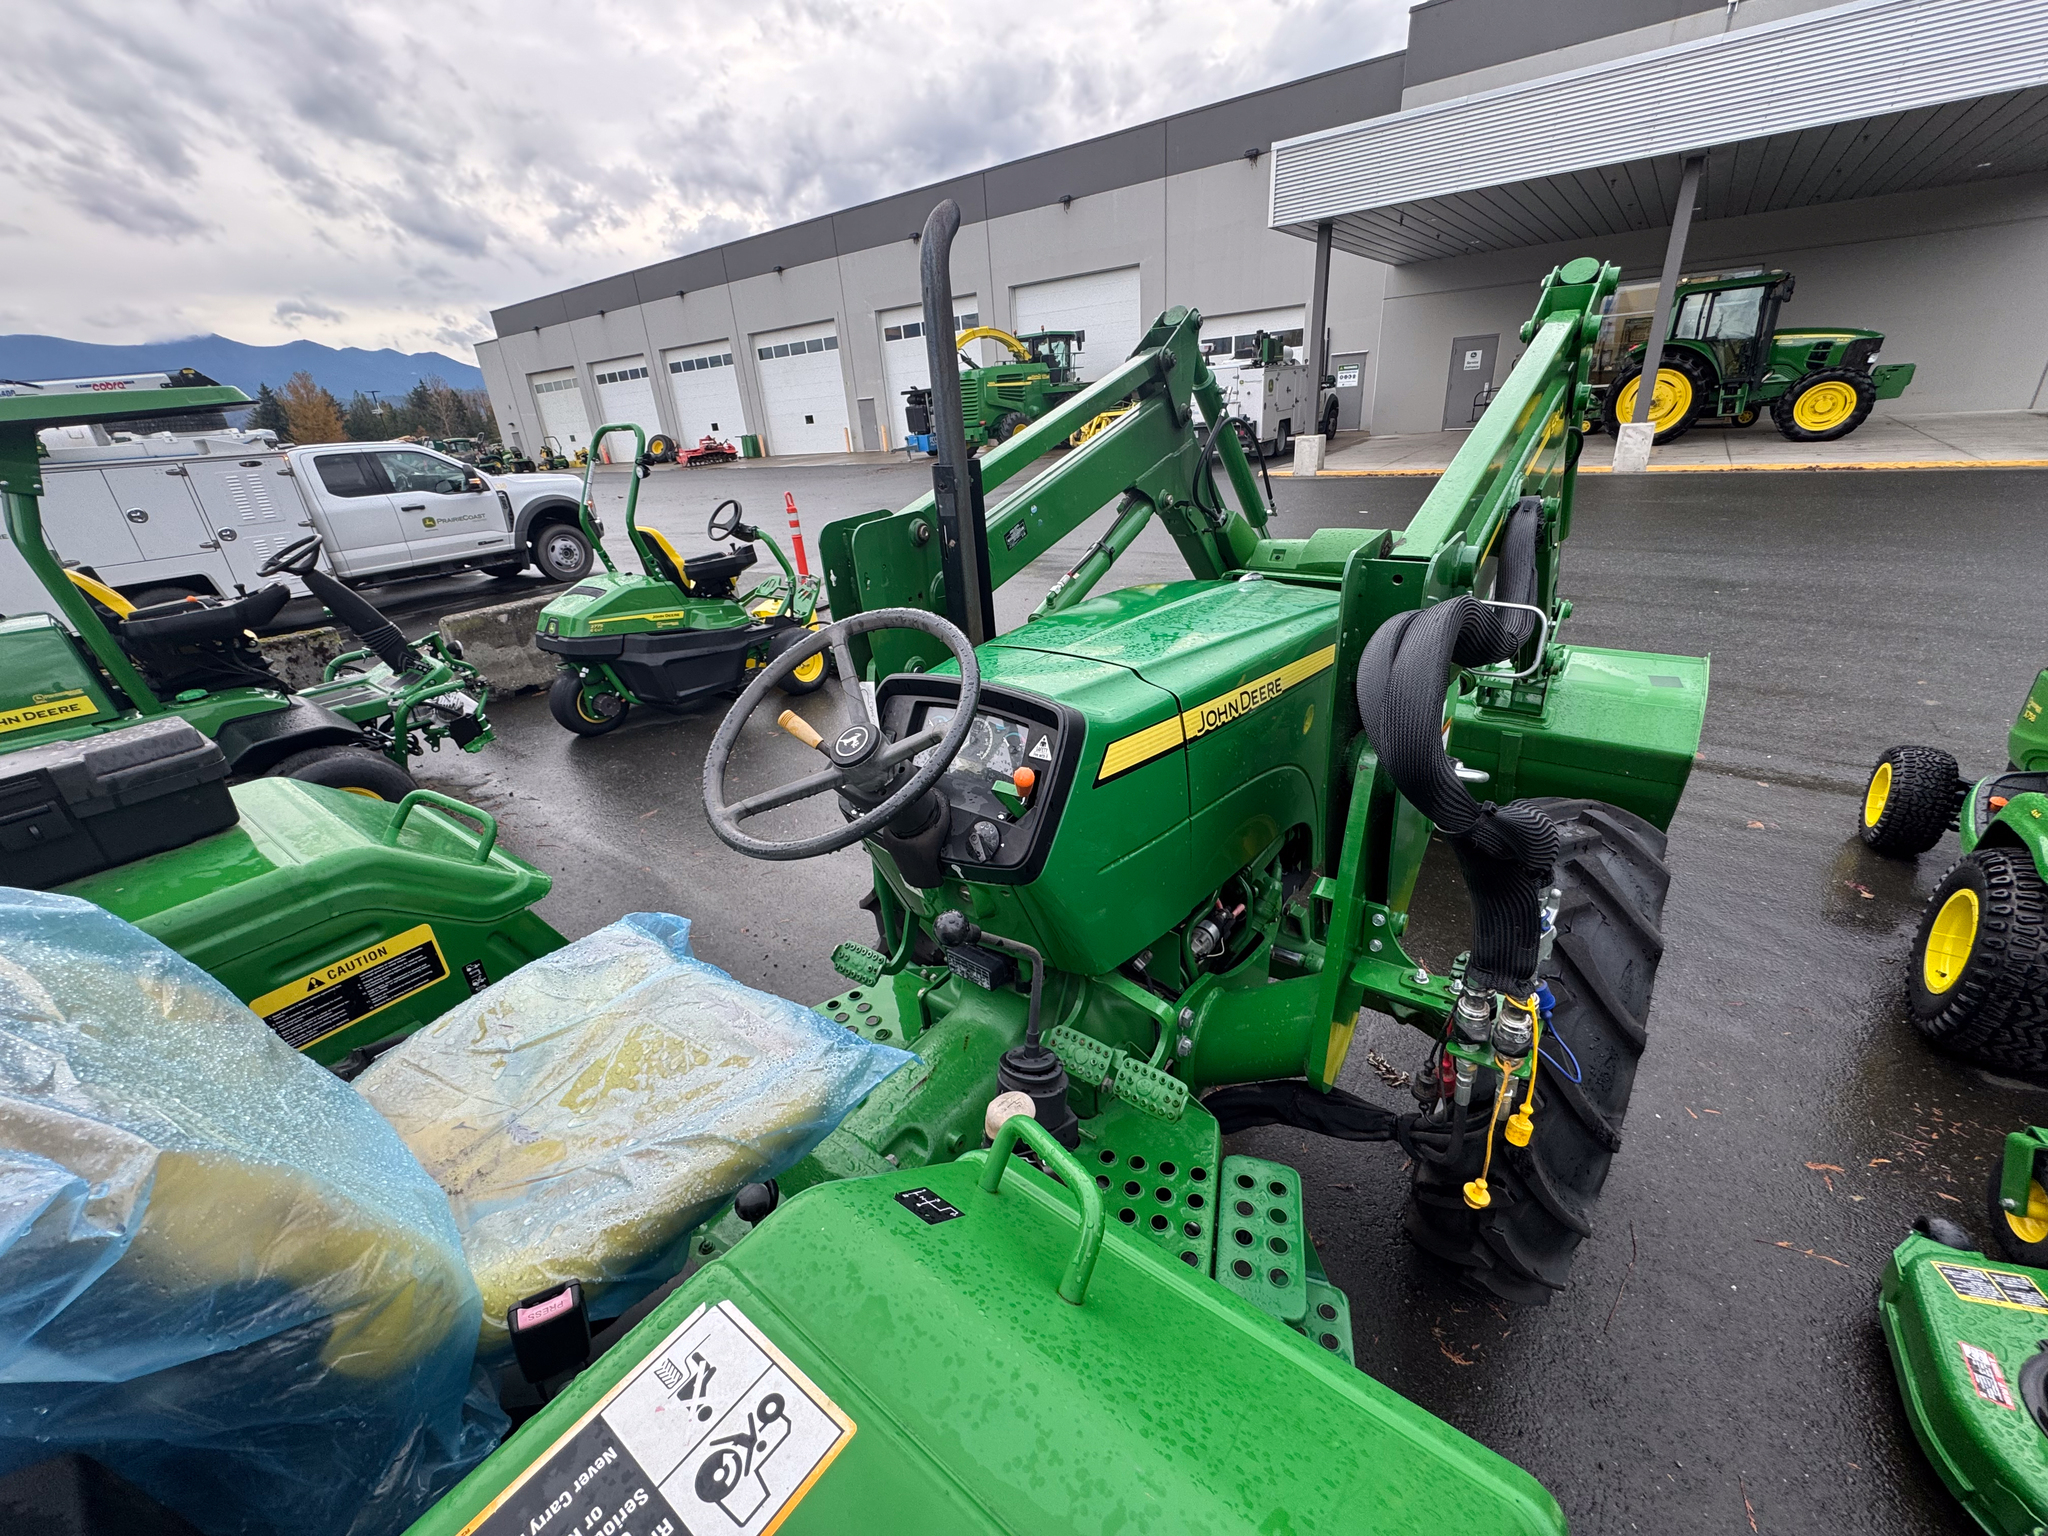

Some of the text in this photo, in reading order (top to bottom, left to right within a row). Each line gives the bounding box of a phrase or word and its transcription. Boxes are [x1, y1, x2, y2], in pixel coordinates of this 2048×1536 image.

[93, 381, 126, 391] cobra
[22, 703, 81, 721] DEERE
[1197, 677, 1282, 733] JOHN DEERE
[327, 946, 388, 981] CAUTION
[528, 1301, 564, 1321] PRESS
[530, 1446, 618, 1536] Never Carry
[584, 1506, 603, 1530] or
